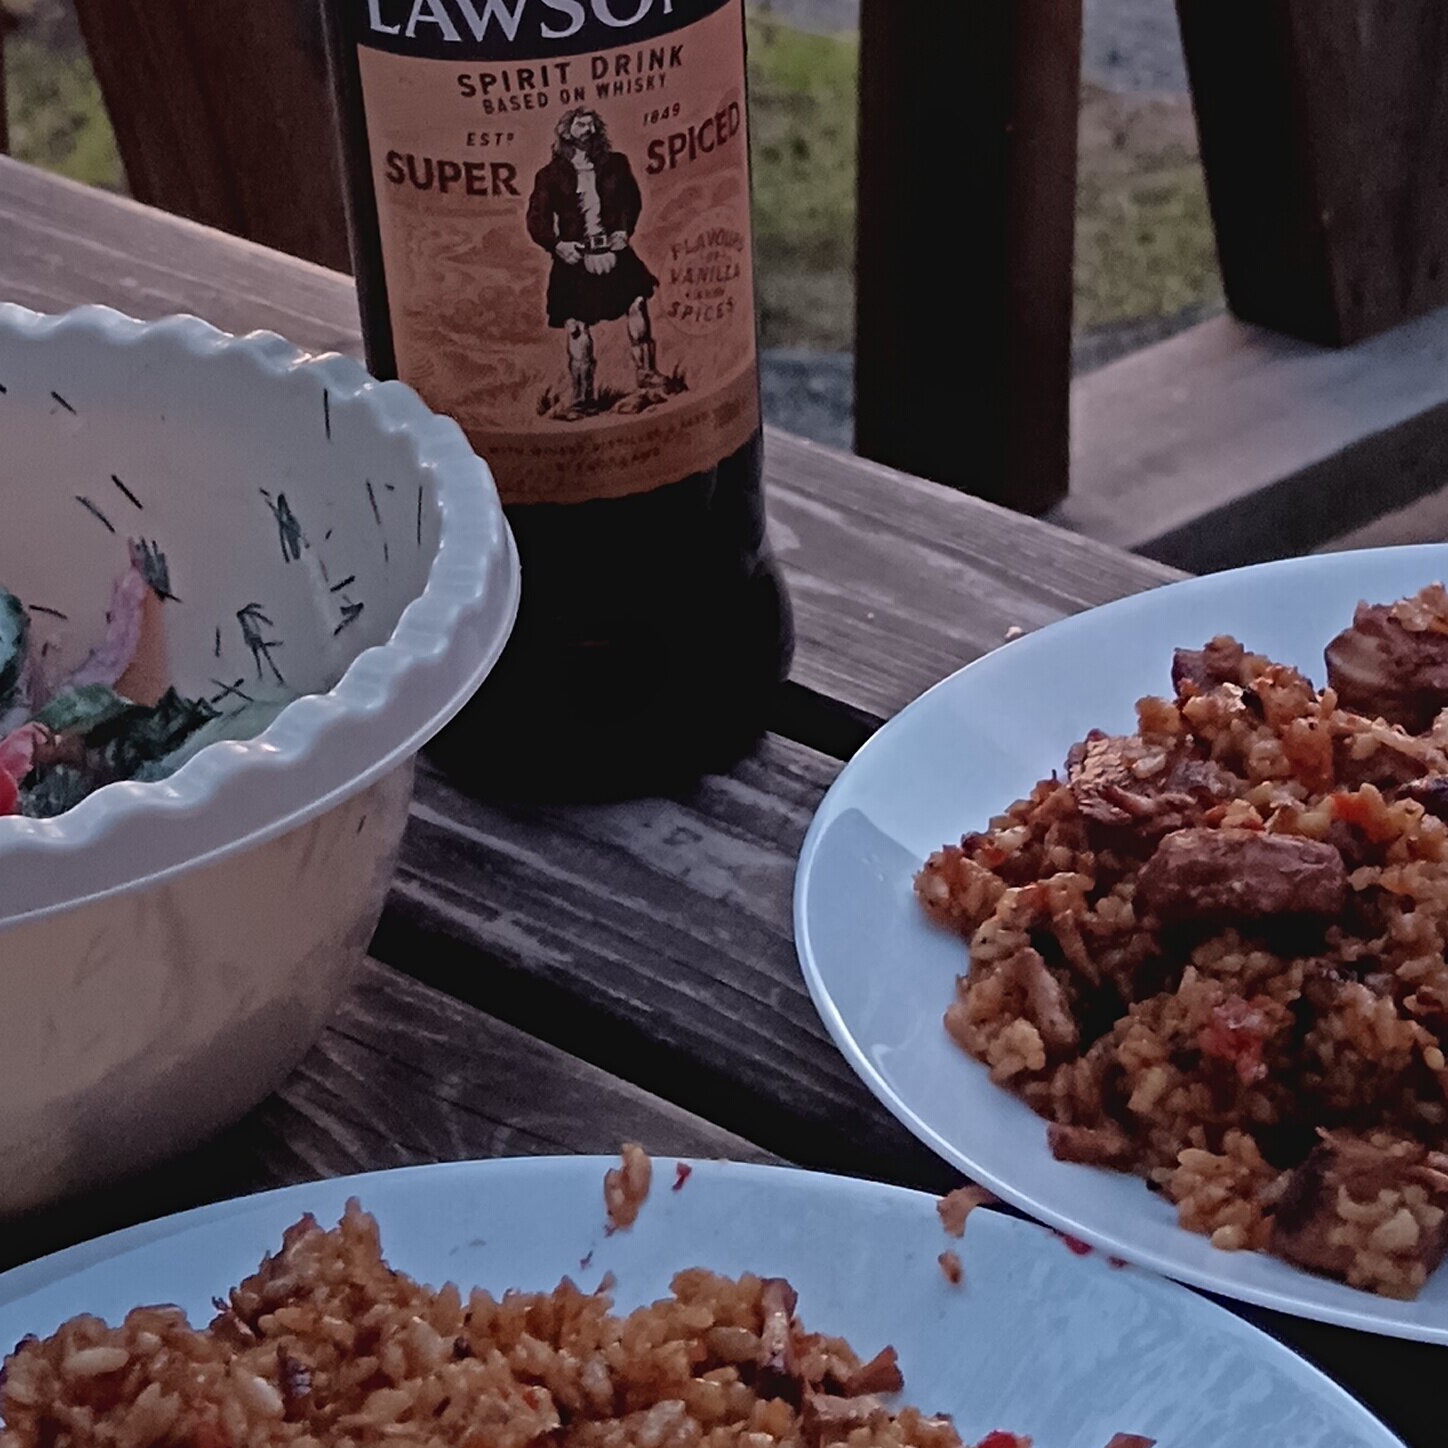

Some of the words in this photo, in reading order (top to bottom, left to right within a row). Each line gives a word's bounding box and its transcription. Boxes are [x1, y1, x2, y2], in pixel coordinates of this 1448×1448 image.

[457, 61, 571, 98] SPIRIT
[591, 44, 684, 81] DRINK
[483, 89, 549, 116] BASED
[560, 86, 586, 102] ON
[597, 72, 667, 100] WHISKY
[643, 103, 681, 126] 1849
[385, 150, 521, 197] SUPER
[644, 101, 741, 176] SPICED
[669, 263, 741, 285] VANILLA
[667, 296, 734, 322] SPICES
